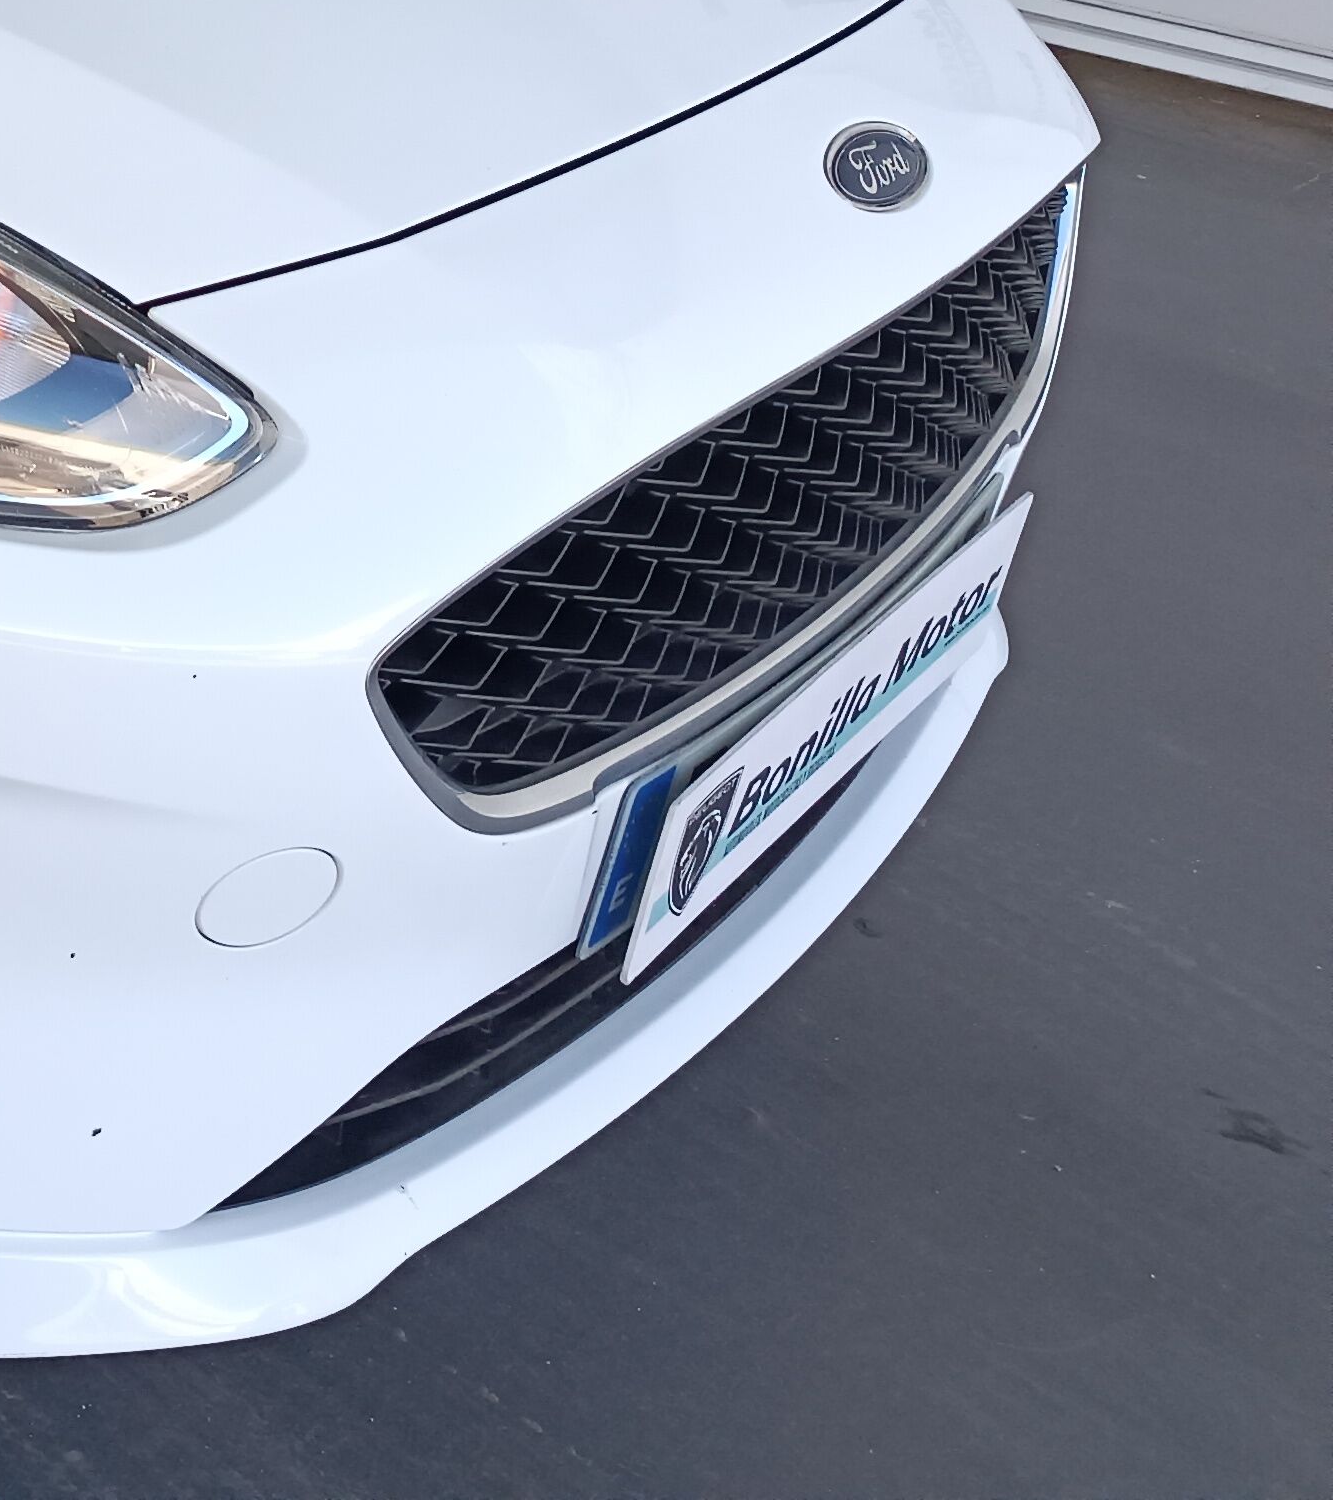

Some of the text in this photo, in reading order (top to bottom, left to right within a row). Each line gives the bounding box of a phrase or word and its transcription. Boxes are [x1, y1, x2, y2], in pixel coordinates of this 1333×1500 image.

[848, 140, 910, 194] Ford
[728, 673, 881, 839] Bonilla
[882, 565, 1003, 694] Motor
